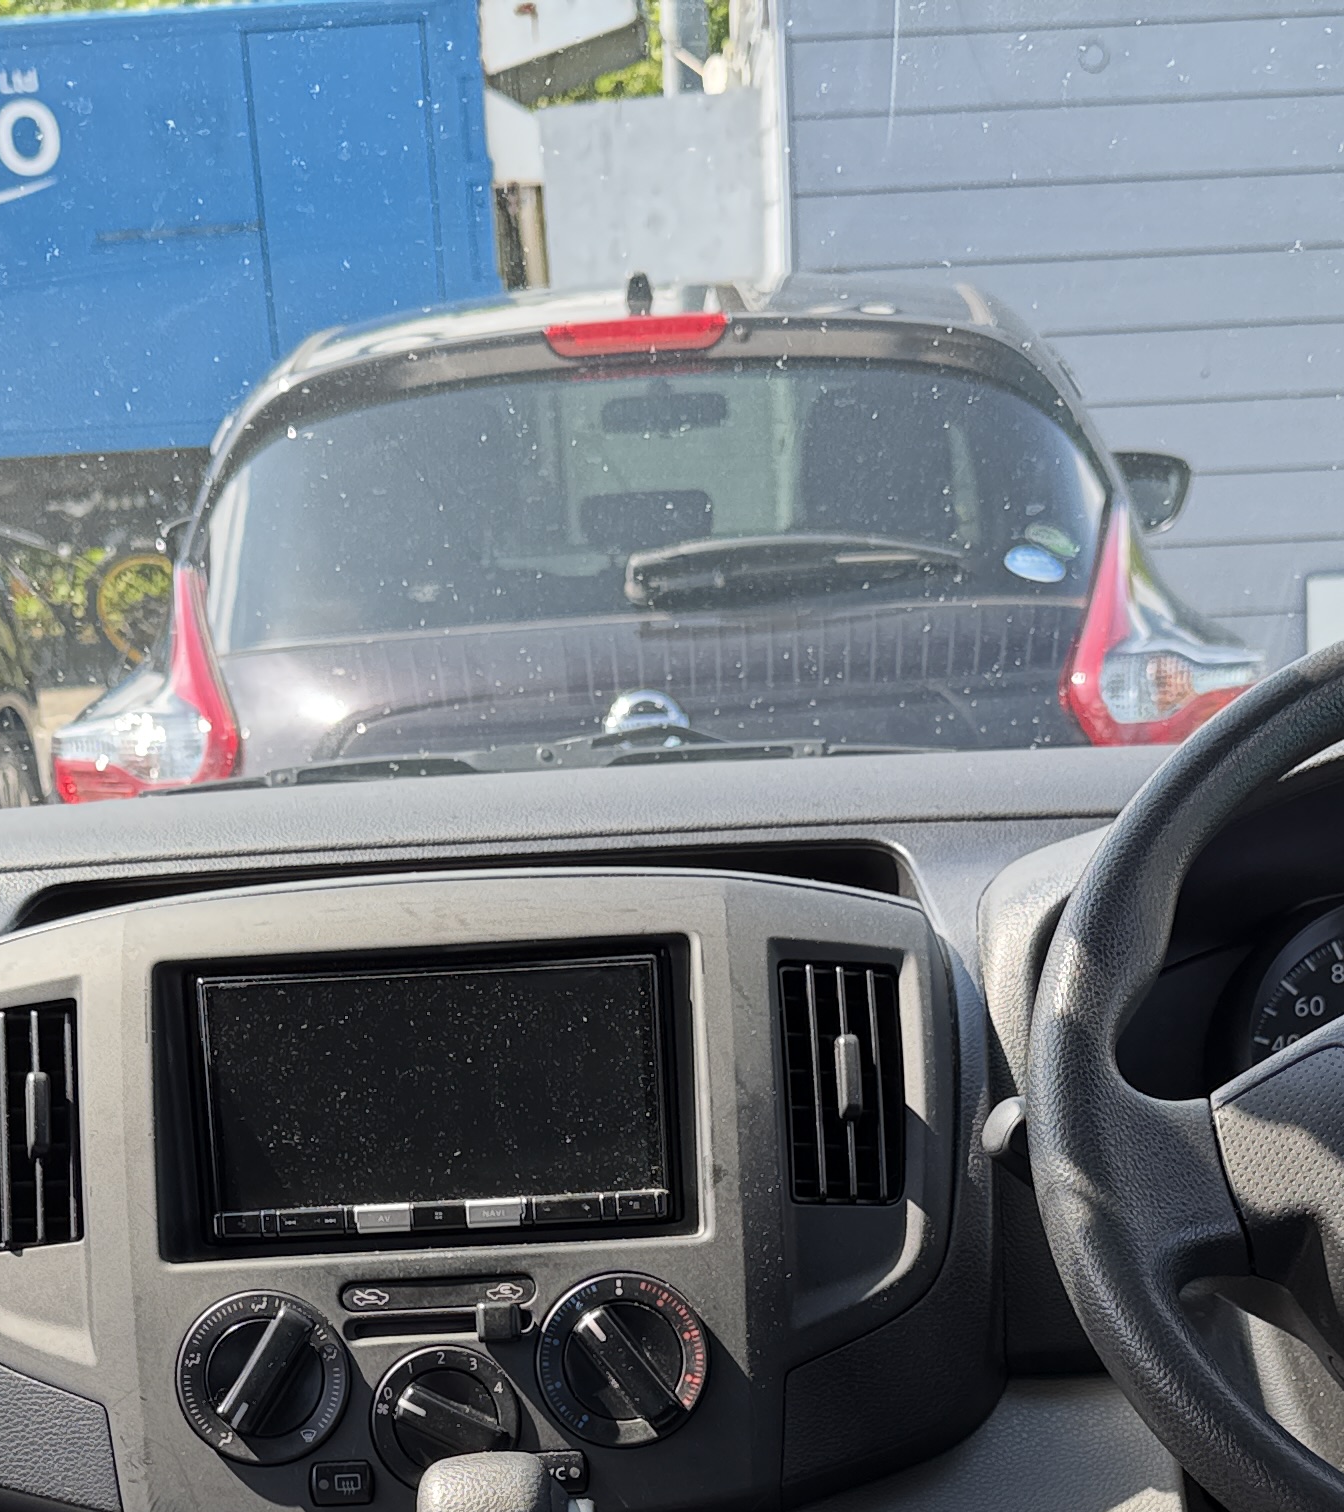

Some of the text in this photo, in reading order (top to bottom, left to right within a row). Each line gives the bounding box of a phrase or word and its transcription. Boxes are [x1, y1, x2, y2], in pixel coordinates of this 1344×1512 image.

[1294, 995, 1326, 1018] 60
[377, 1214, 392, 1224] AV
[481, 1209, 506, 1218] NAVI
[436, 1351, 447, 1365] 2
[469, 1357, 479, 1371] 3
[407, 1361, 415, 1375] 1
[383, 1386, 394, 1401] 0
[492, 1381, 504, 1394] 4
